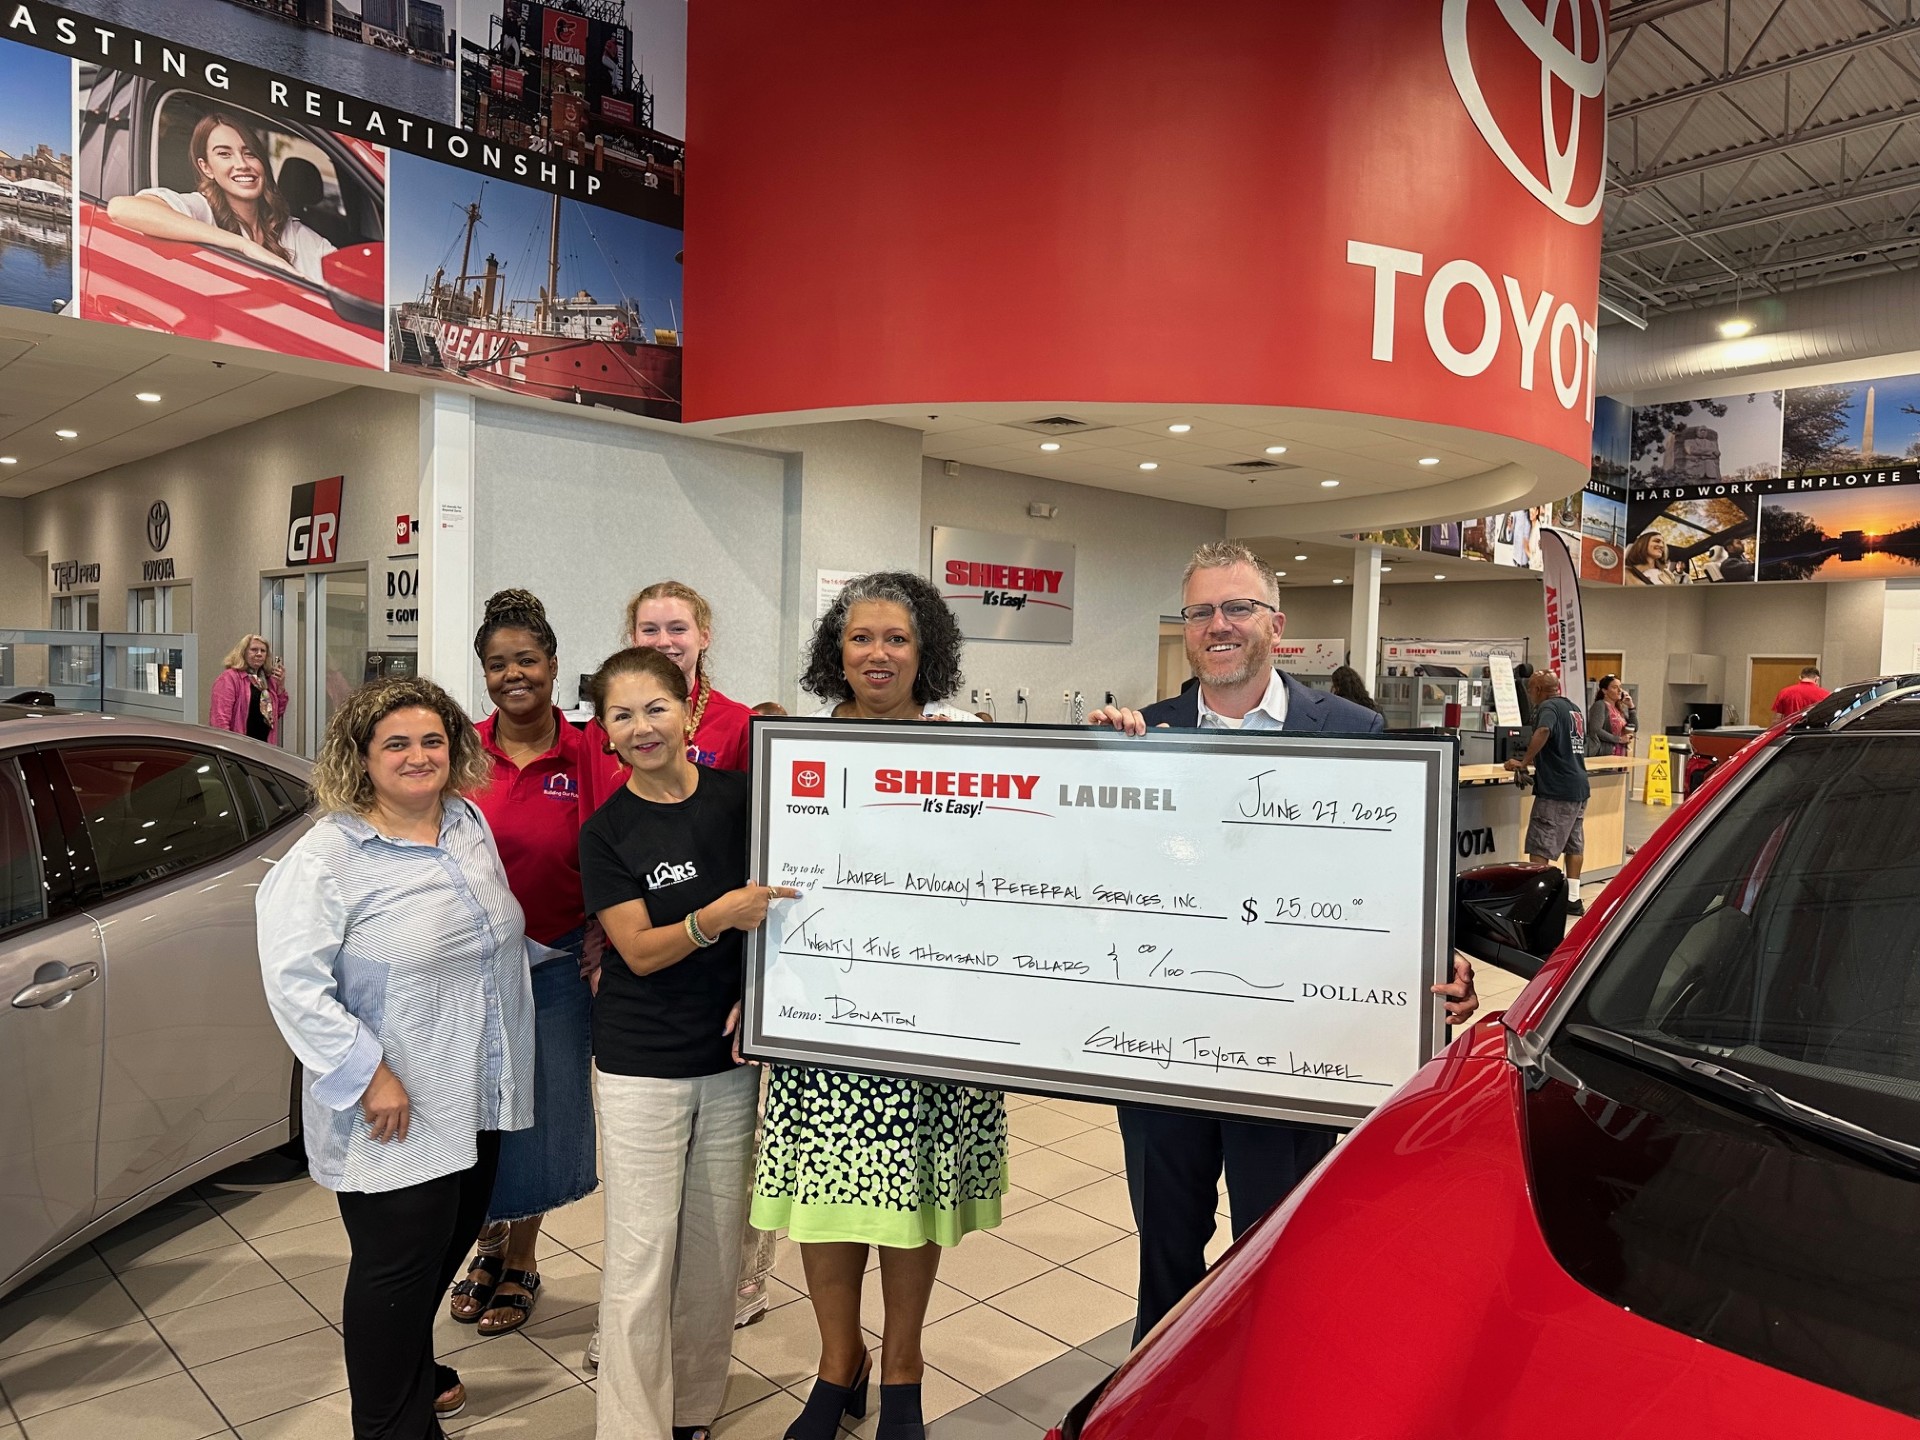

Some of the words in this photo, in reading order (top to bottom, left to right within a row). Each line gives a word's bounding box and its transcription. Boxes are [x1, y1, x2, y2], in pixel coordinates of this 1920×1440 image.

[544, 47, 586, 66] BRDLAND
[9, 4, 230, 90] ASTING
[269, 80, 602, 196] RELATIONSHIP
[1636, 488, 1685, 501] HARD
[1698, 482, 1754, 497] WORK
[1787, 471, 1901, 490] EMPLOYEE
[288, 512, 336, 562] GR
[80, 562, 101, 583] PRO
[142, 557, 175, 581] TOYOTA
[945, 559, 1064, 594] SHEEHY
[999, 591, 1028, 611] Easy!
[1545, 584, 1562, 697] HEEHY
[1559, 618, 1567, 645] Easy!
[1565, 598, 1578, 673] LAUREL
[874, 769, 1041, 800] SHEEHY
[1059, 784, 1177, 812] LAUREL
[1239, 769, 1301, 821] JUNE
[1352, 802, 1398, 824] 2025
[786, 804, 830, 816] TOYOTA
[922, 798, 944, 813] It's
[945, 799, 984, 818] Easy!
[1457, 827, 1496, 858] OTA
[782, 862, 798, 874] Pay
[800, 865, 809, 874] to
[811, 863, 825, 875] the
[836, 853, 895, 886] LAUREL
[905, 873, 970, 907] ADVOCACY
[991, 877, 1082, 900] REFERRAL
[806, 879, 818, 890] of
[1241, 896, 1258, 926] $
[784, 907, 853, 974] TWENTY
[863, 937, 900, 960] FIVE
[909, 944, 999, 967] THOUSAND
[1012, 955, 1090, 974] DOLLARS
[1302, 982, 1408, 1007] DOLLARS
[778, 1005, 822, 1022] Memo:
[824, 994, 916, 1027] DONATION
[1084, 1026, 1172, 1069] SHEEHY
[1183, 1036, 1249, 1073] TOYOTA
[1289, 1052, 1363, 1078] LAUREL
